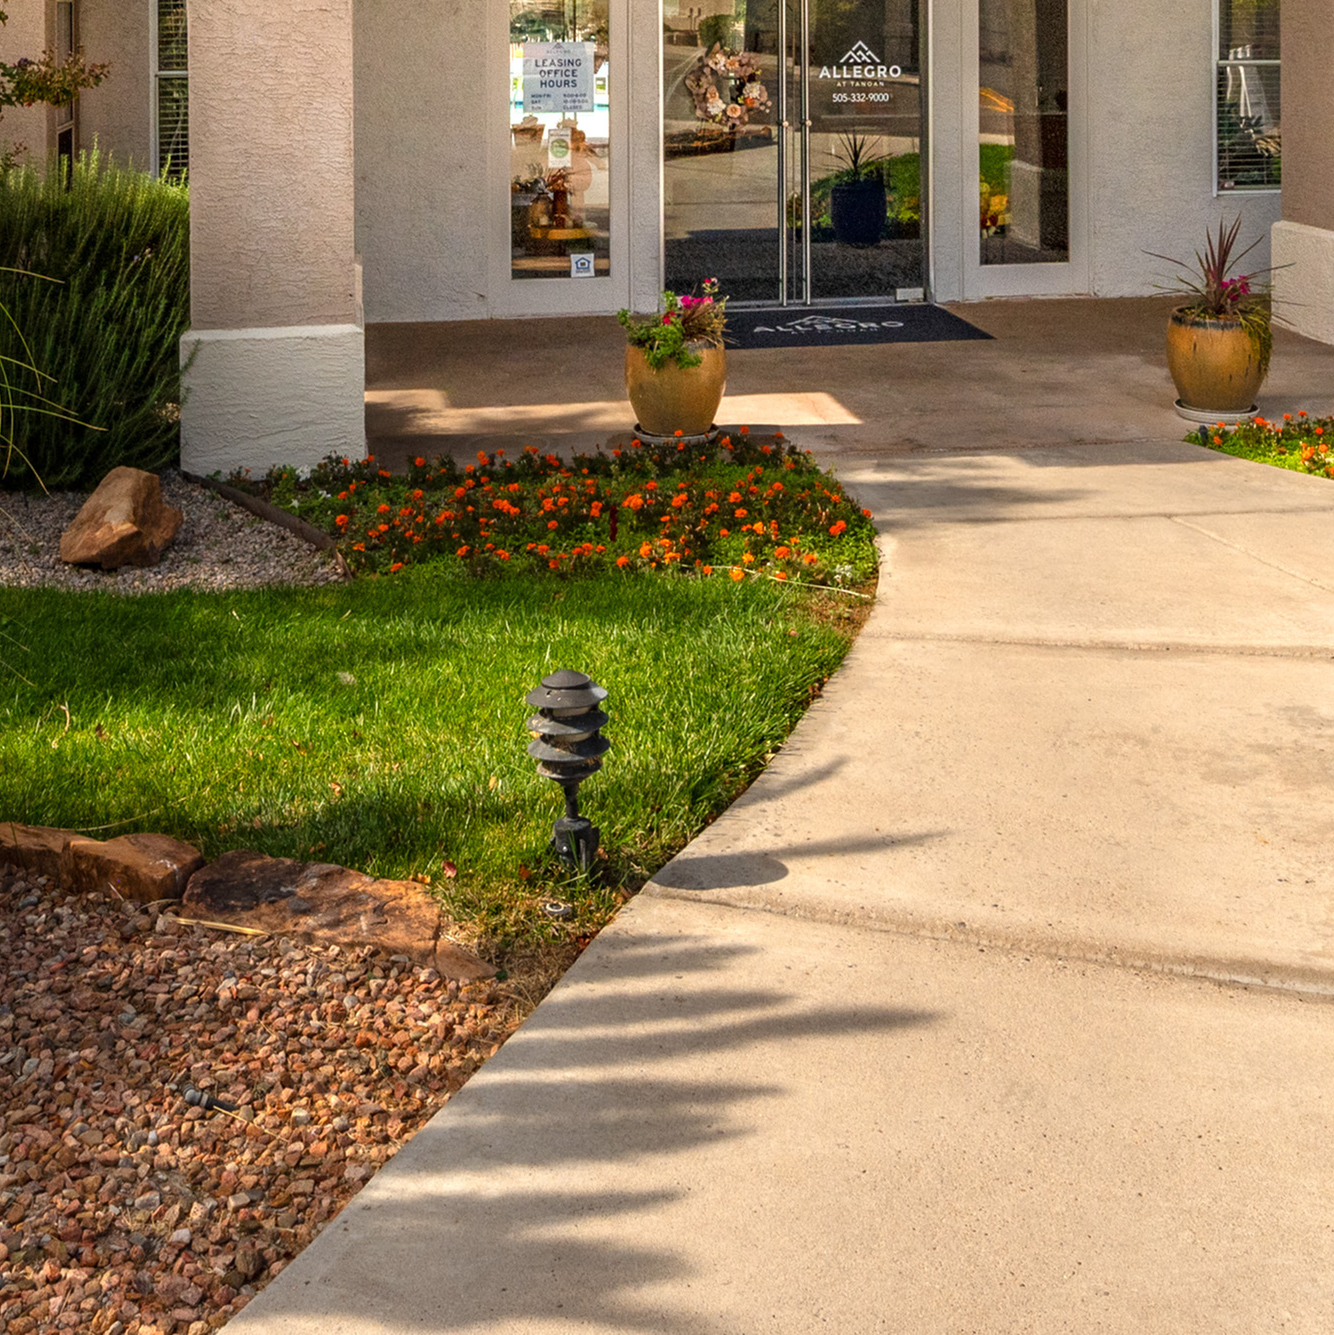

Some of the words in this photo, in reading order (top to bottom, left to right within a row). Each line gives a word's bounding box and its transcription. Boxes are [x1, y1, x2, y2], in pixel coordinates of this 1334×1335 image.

[534, 58, 582, 67] LEASING
[539, 69, 578, 78] OFFICE
[818, 65, 902, 79] ALLEGRO
[540, 79, 578, 88] HOURS
[832, 92, 889, 102] 505-332-9000
[753, 320, 904, 332] ALLEGRO
